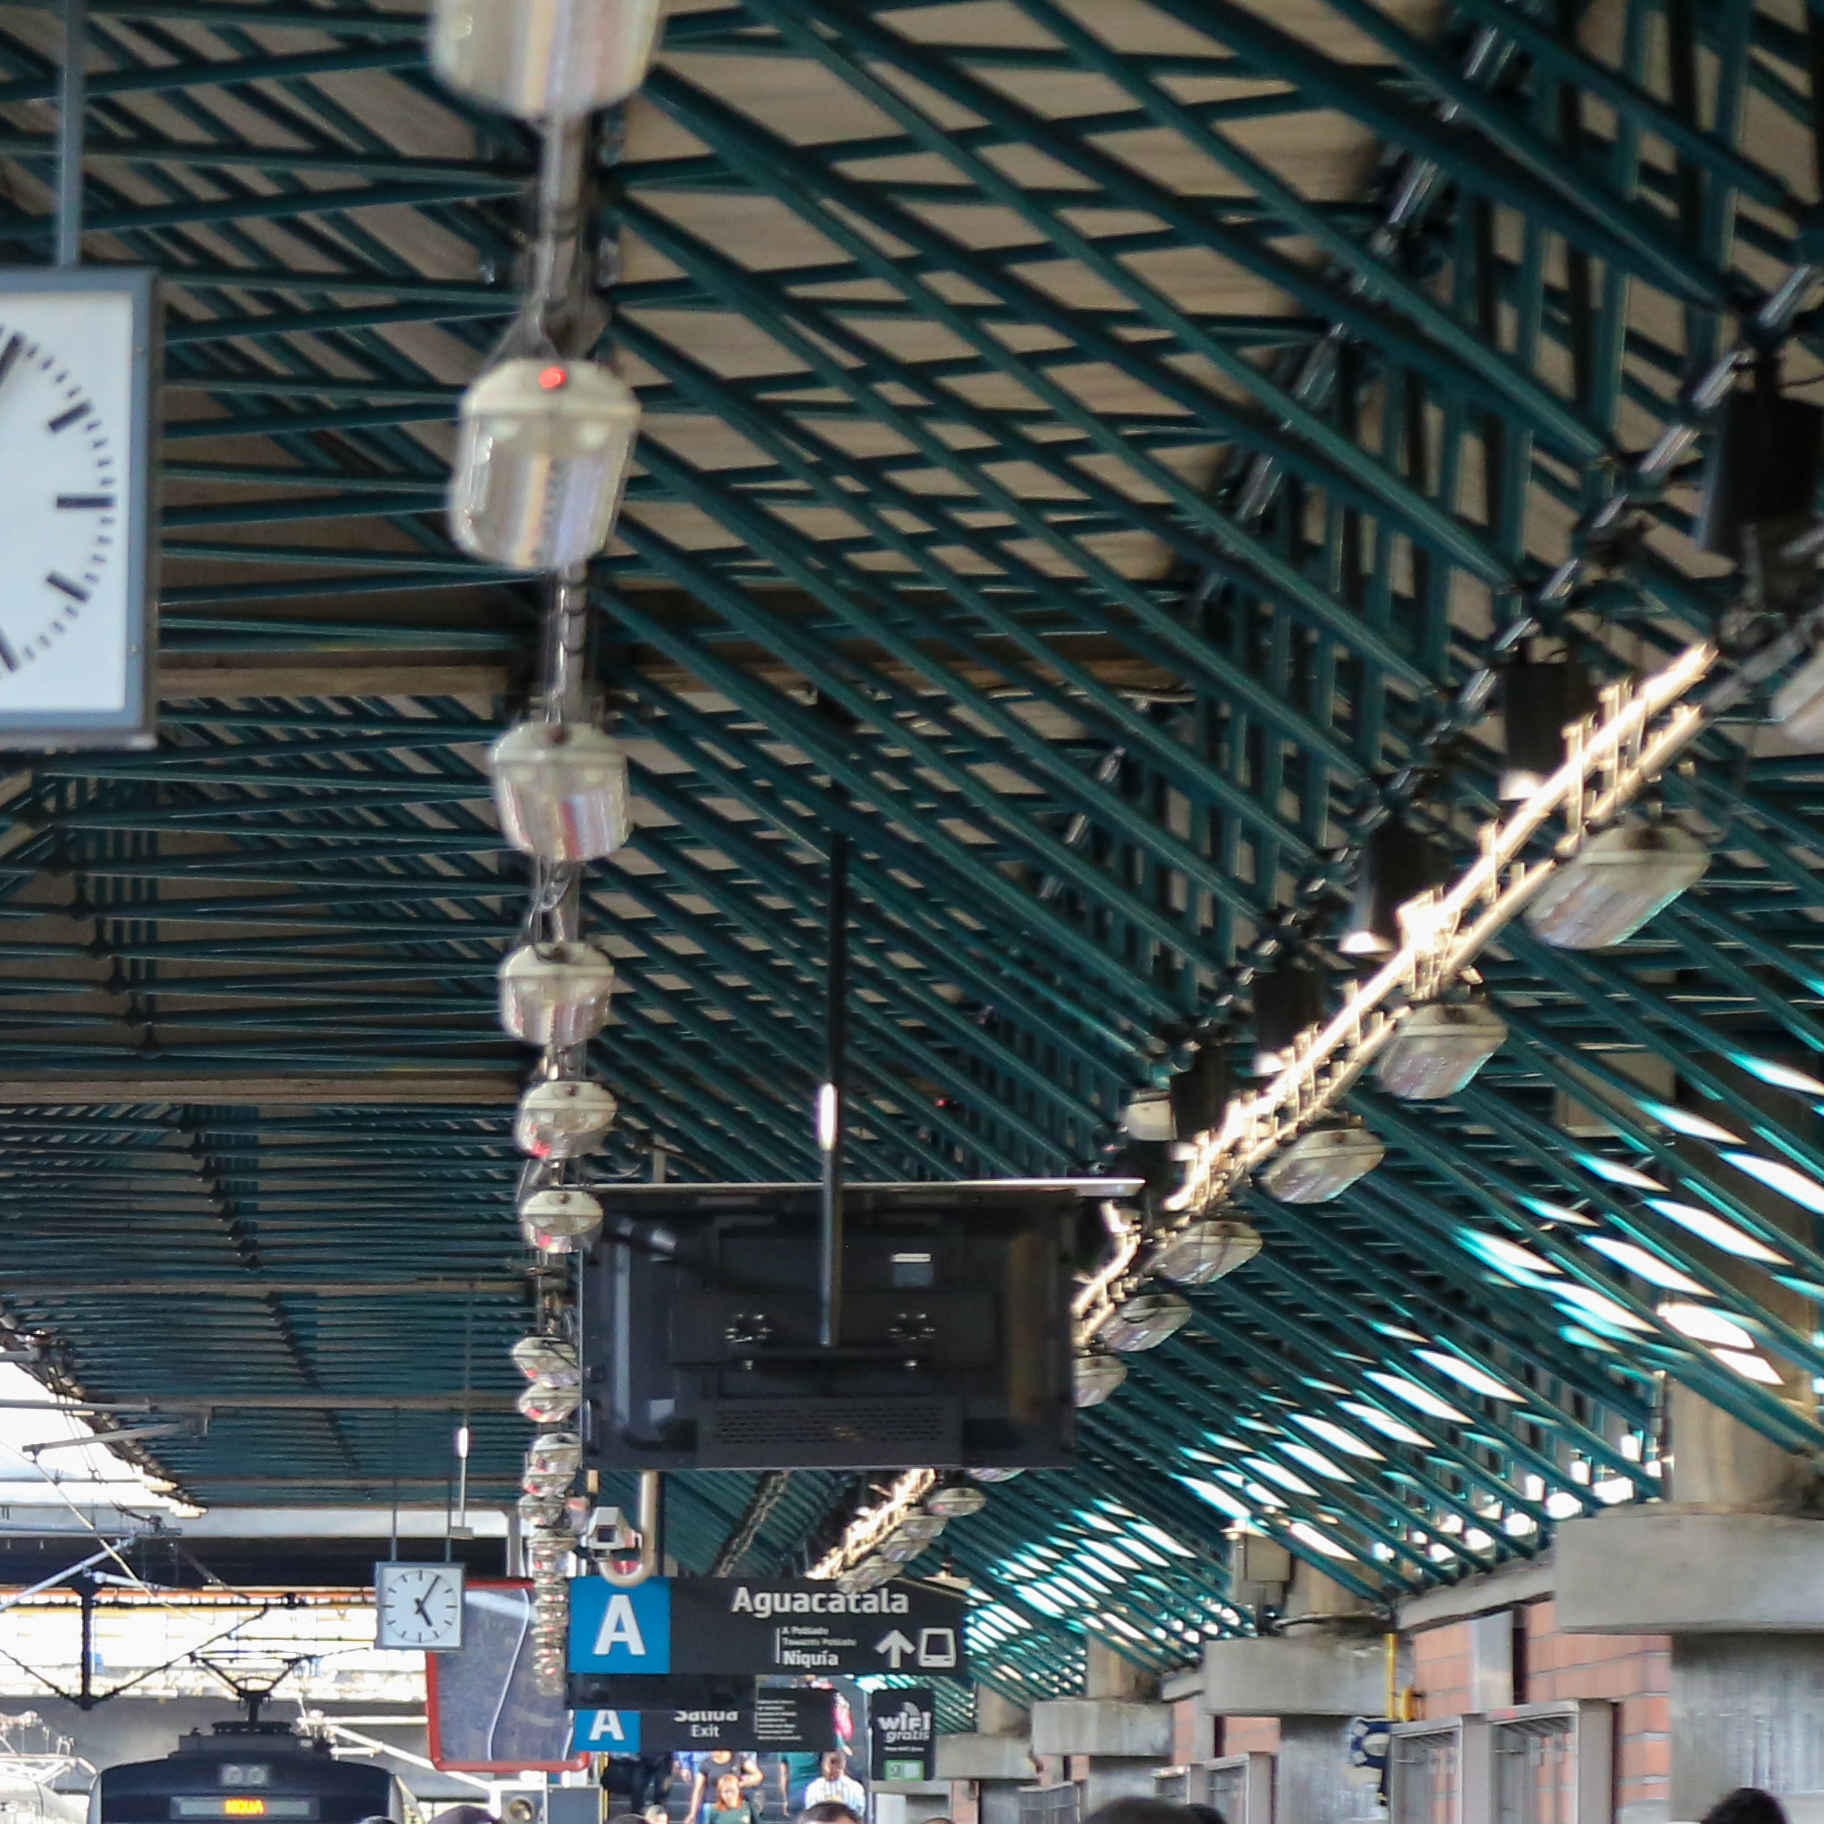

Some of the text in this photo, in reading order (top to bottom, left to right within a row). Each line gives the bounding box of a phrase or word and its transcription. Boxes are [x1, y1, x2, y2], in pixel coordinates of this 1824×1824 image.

[731, 1586, 910, 1619] Aguacatala
[592, 1594, 646, 1656] A
[588, 1710, 625, 1741] A
[690, 1725, 720, 1738] Exit
